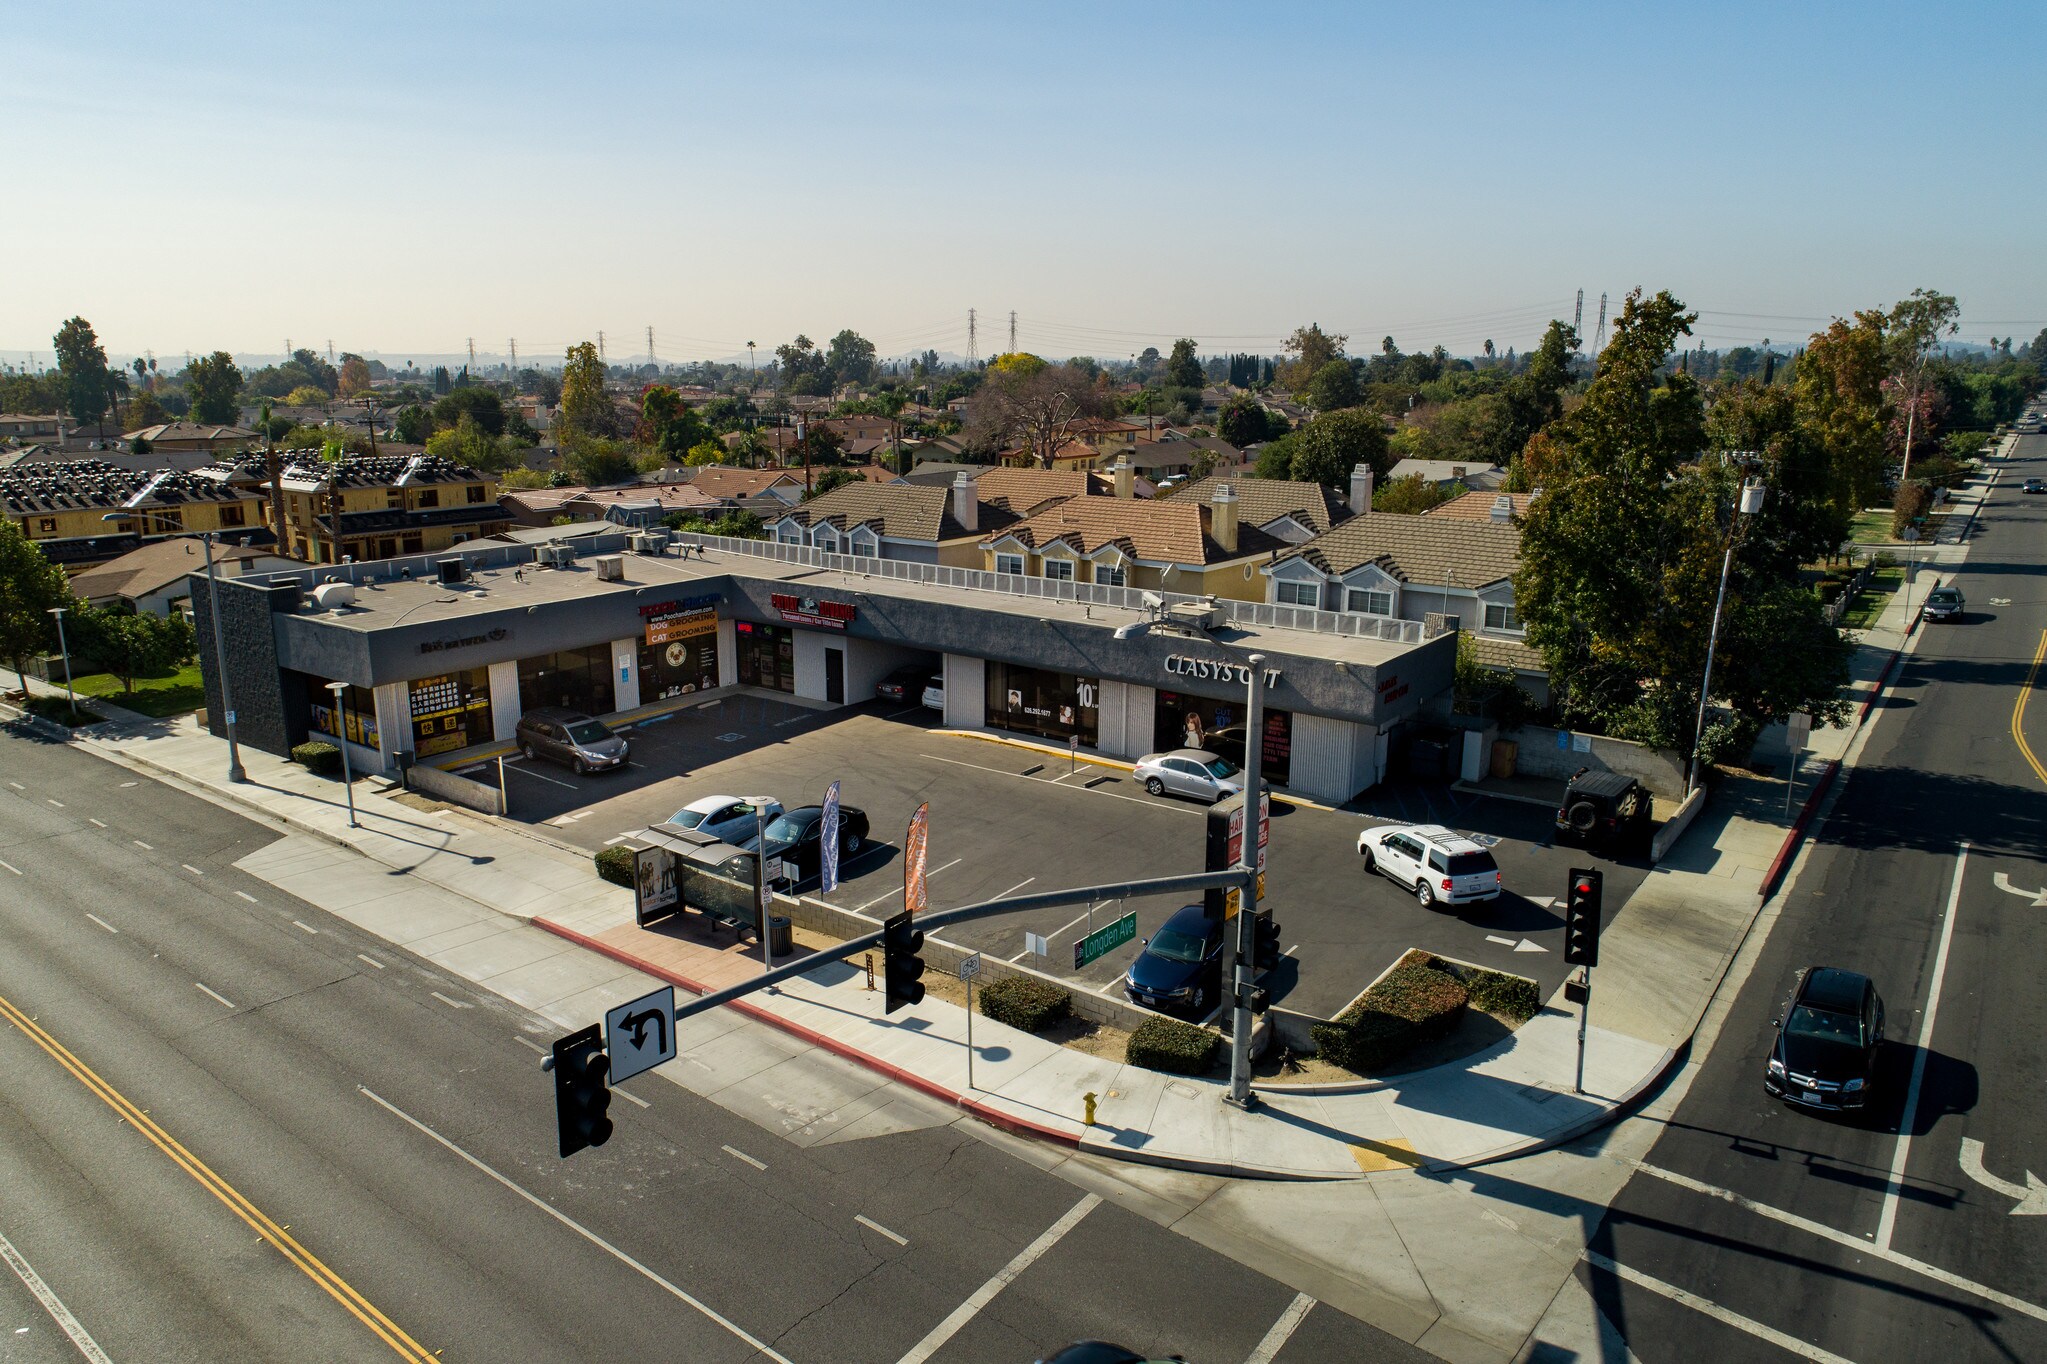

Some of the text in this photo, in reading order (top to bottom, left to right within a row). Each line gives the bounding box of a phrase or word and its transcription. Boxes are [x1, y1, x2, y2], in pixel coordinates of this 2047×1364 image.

[650, 606, 713, 623] www.PoochandGroom.com
[650, 612, 716, 631] DOG GROOMING
[782, 612, 800, 621] Personal
[800, 615, 812, 624] Loans
[832, 620, 844, 629] Loans
[651, 624, 716, 643] CAT GROOMING
[1164, 653, 1233, 682] CLASYS
[1076, 683, 1093, 708] 10
[916, 826, 926, 847] CAT
[660, 892, 676, 903] family
[1085, 920, 1134, 958] Longden Ave
